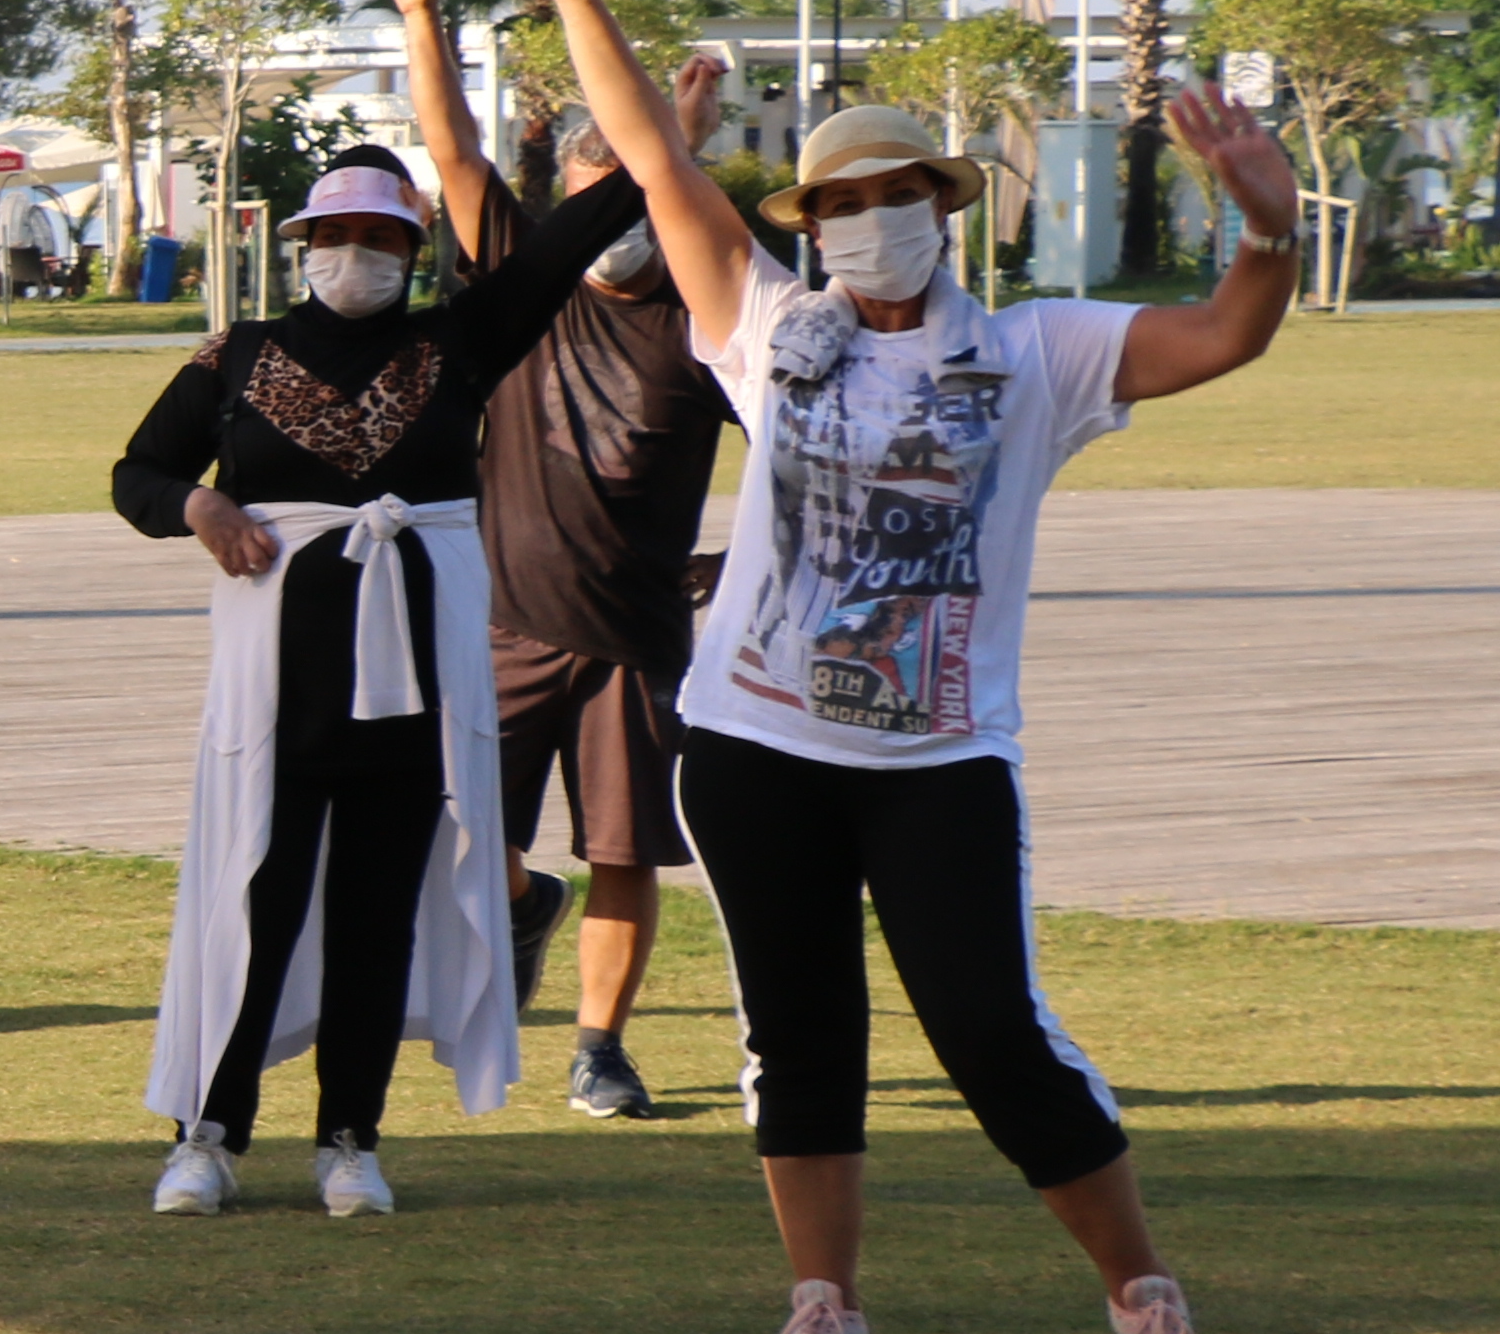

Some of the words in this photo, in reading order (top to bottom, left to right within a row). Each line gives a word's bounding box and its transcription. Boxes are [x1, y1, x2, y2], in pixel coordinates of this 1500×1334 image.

[840, 524, 975, 596] Youth
[943, 595, 973, 660] NEW
[813, 666, 866, 698] 8TH
[940, 664, 971, 732] YORK
[813, 701, 893, 729] ENDENT
[902, 716, 929, 734] SU
